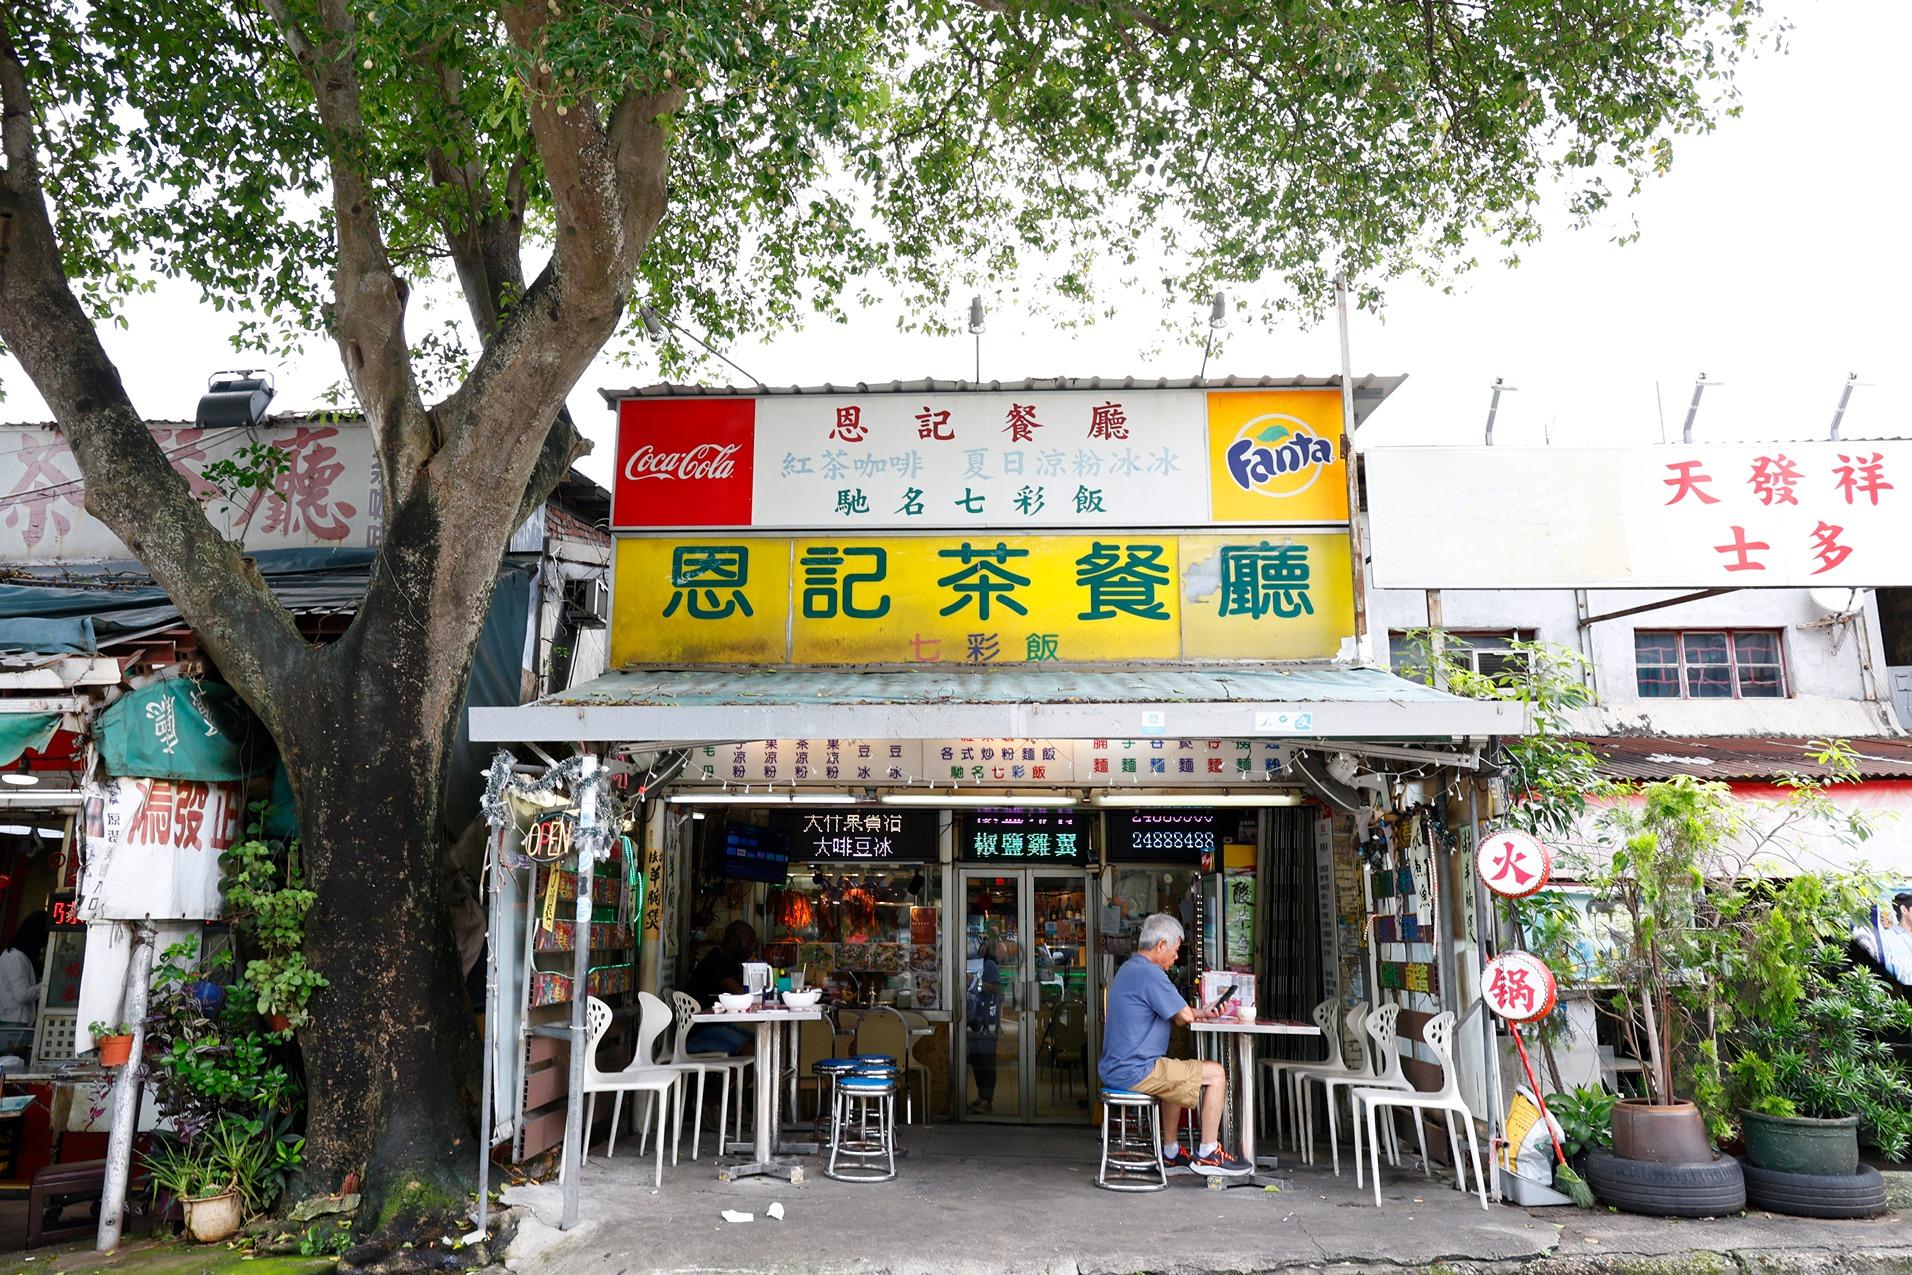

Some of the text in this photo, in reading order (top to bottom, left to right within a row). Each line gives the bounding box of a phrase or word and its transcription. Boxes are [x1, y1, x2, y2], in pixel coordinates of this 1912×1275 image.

[829, 401, 1130, 443] 恩記餐廳
[624, 443, 743, 481] Coca-Cola
[781, 449, 924, 480] 紅茶咖啡
[1226, 431, 1333, 491] Fanta
[1663, 452, 1895, 506] 天發祥
[834, 485, 1107, 517] 馳名七彩飯
[1713, 520, 1854, 576] 士多
[662, 541, 1315, 621] 恩記茶餐廳
[909, 632, 1060, 663] 七彩飯
[950, 765, 1047, 780] 馳名七彩飯
[527, 820, 572, 858] OPEN
[1132, 831, 1215, 849] 24888488
[1490, 841, 1536, 886] 火
[1487, 967, 1536, 1014] 锅
